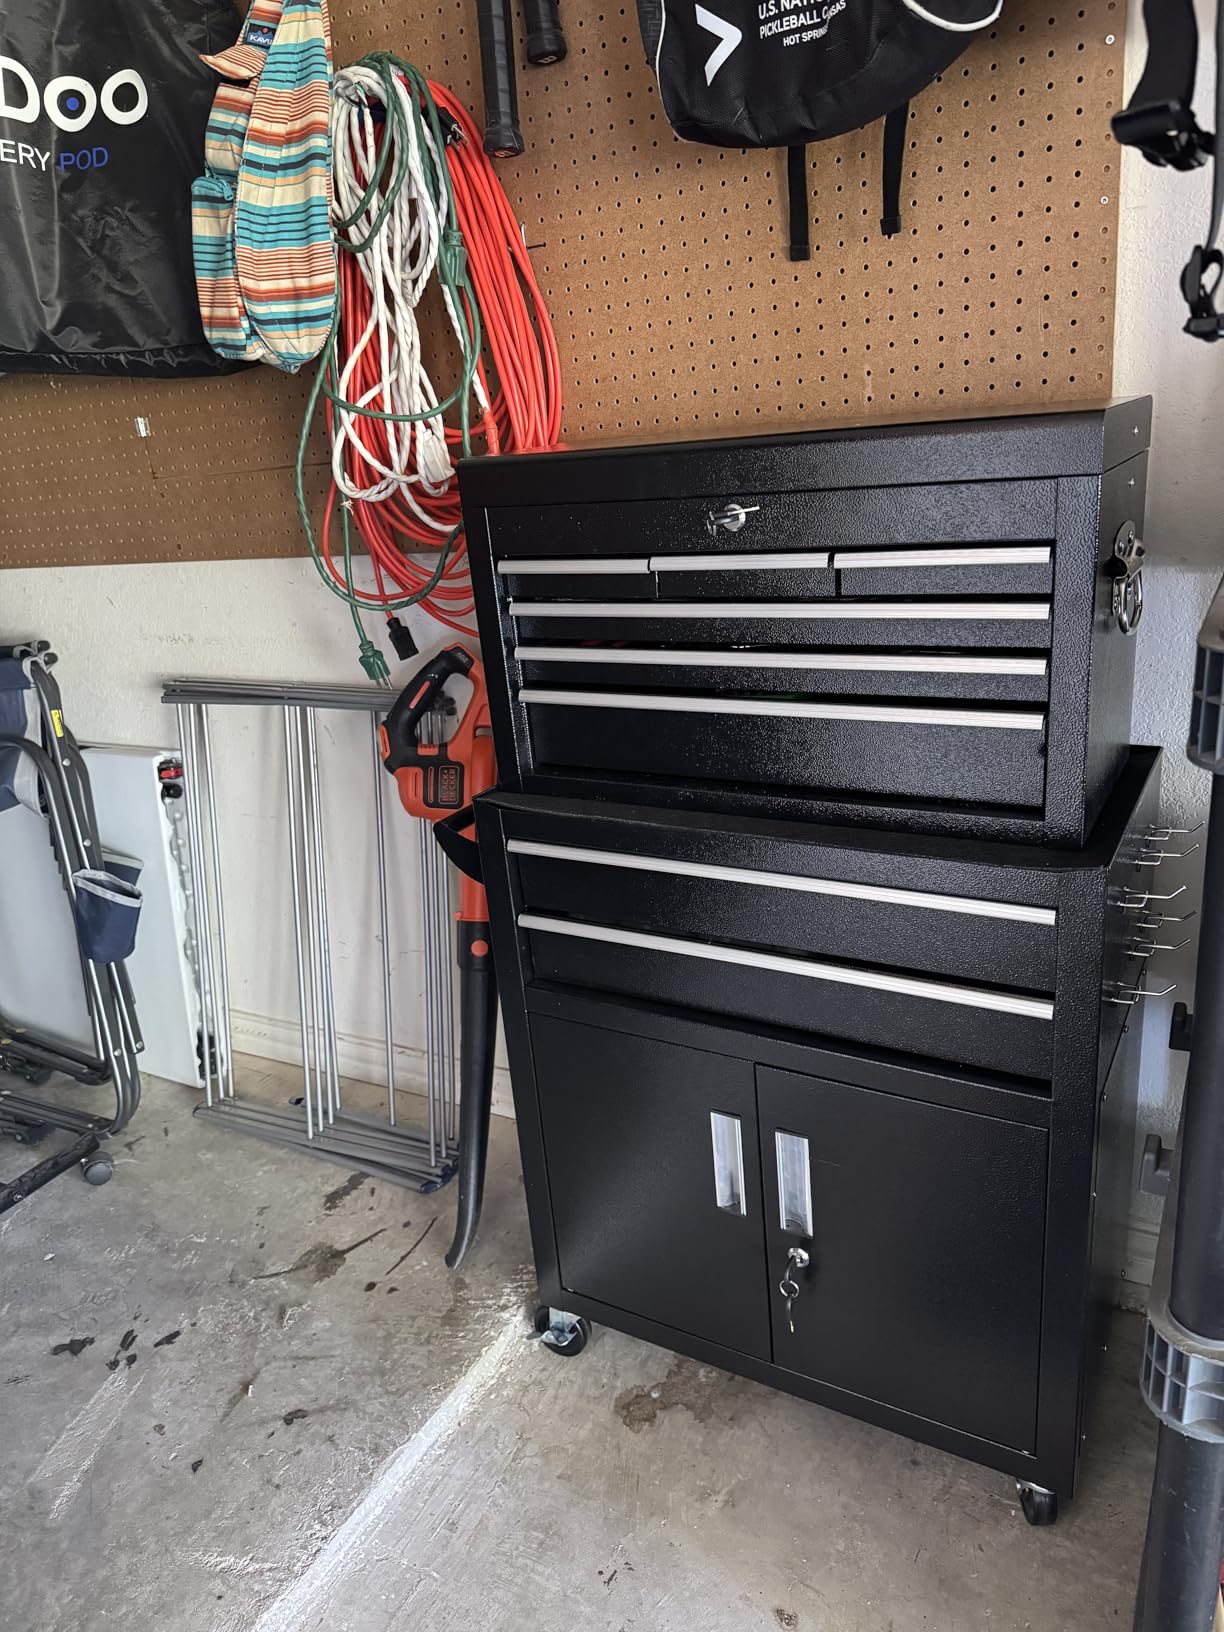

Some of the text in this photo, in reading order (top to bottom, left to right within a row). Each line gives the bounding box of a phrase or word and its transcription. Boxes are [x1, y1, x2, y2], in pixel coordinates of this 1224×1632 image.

[758, 0, 779, 20] U.S.
[759, 9, 821, 40] PICKLEBALL
[249, 34, 273, 45] KAVU
[783, 34, 800, 47] HOT
[59, 146, 109, 174] POD
